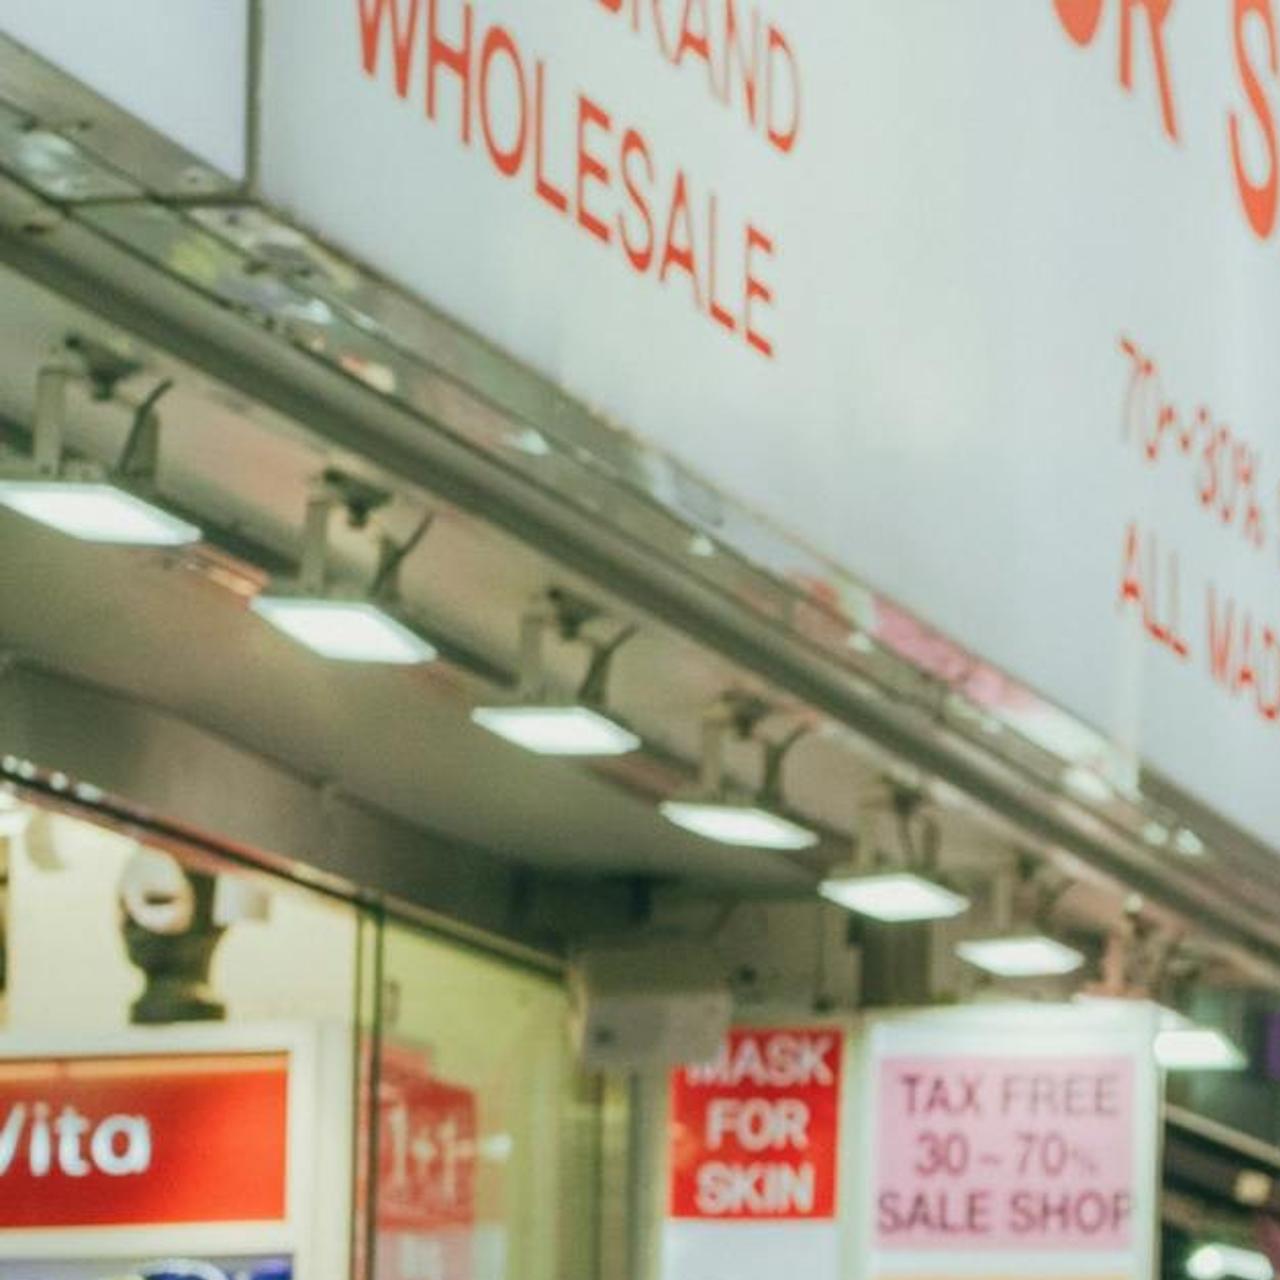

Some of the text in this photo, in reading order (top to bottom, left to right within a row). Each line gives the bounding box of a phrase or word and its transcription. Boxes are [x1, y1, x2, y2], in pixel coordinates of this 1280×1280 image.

[593, 0, 799, 152] AND
[357, 0, 776, 358] WHOLESALE
[1117, 520, 1188, 660] ALL
[901, 1074, 1120, 1117] TAX FREE
[706, 1097, 810, 1151] FOR
[696, 1162, 815, 1213] SKIN
[877, 1190, 1132, 1235] SALE SHOP
